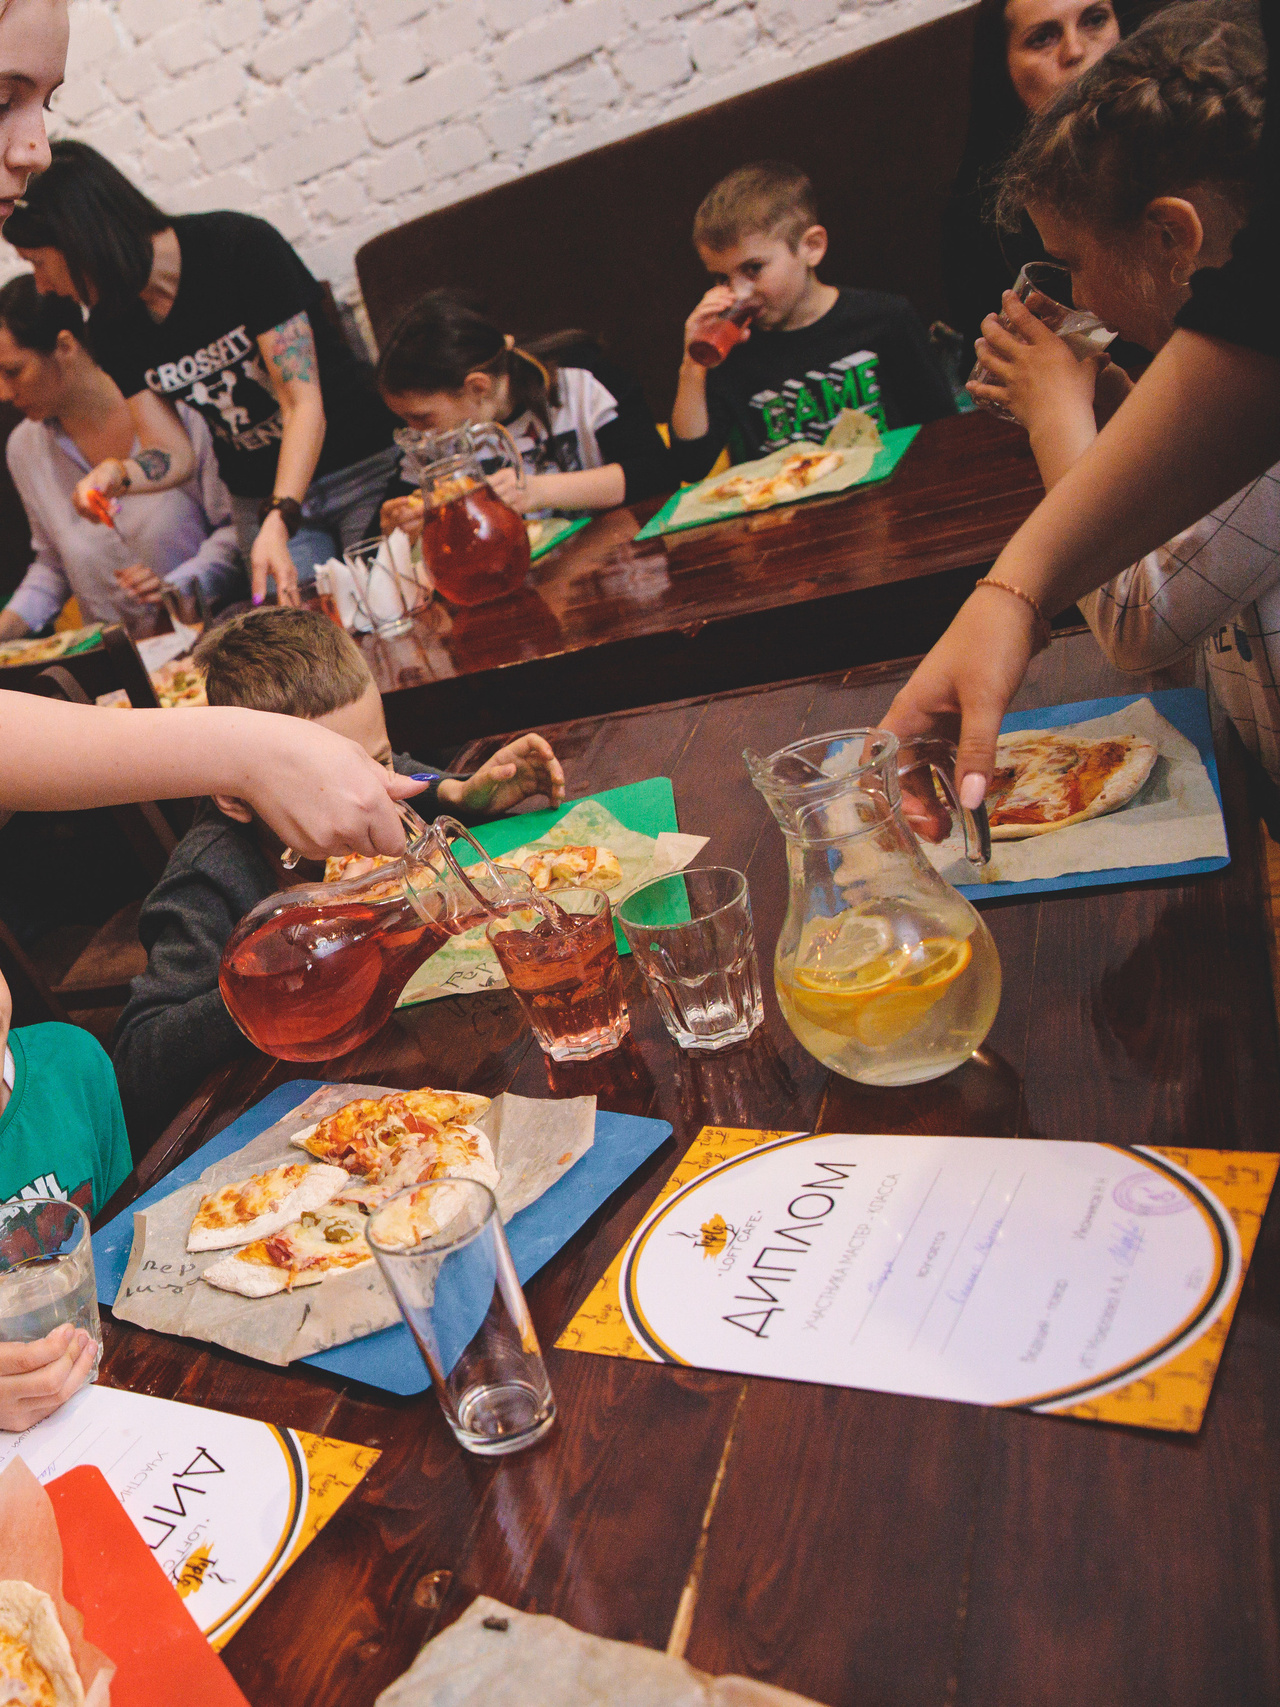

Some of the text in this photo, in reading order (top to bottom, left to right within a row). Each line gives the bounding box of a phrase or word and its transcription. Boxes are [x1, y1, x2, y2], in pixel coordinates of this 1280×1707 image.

[144, 324, 254, 393] CROSSFIT
[752, 350, 881, 443] GAME
[718, 1215, 762, 1272] LOFT CAFE
[721, 1162, 858, 1340] ДИПЛОМ
[119, 1450, 169, 1504] УЧАСТНИ
[143, 1446, 225, 1549] ДИП
[176, 1524, 208, 1558] LOFT
